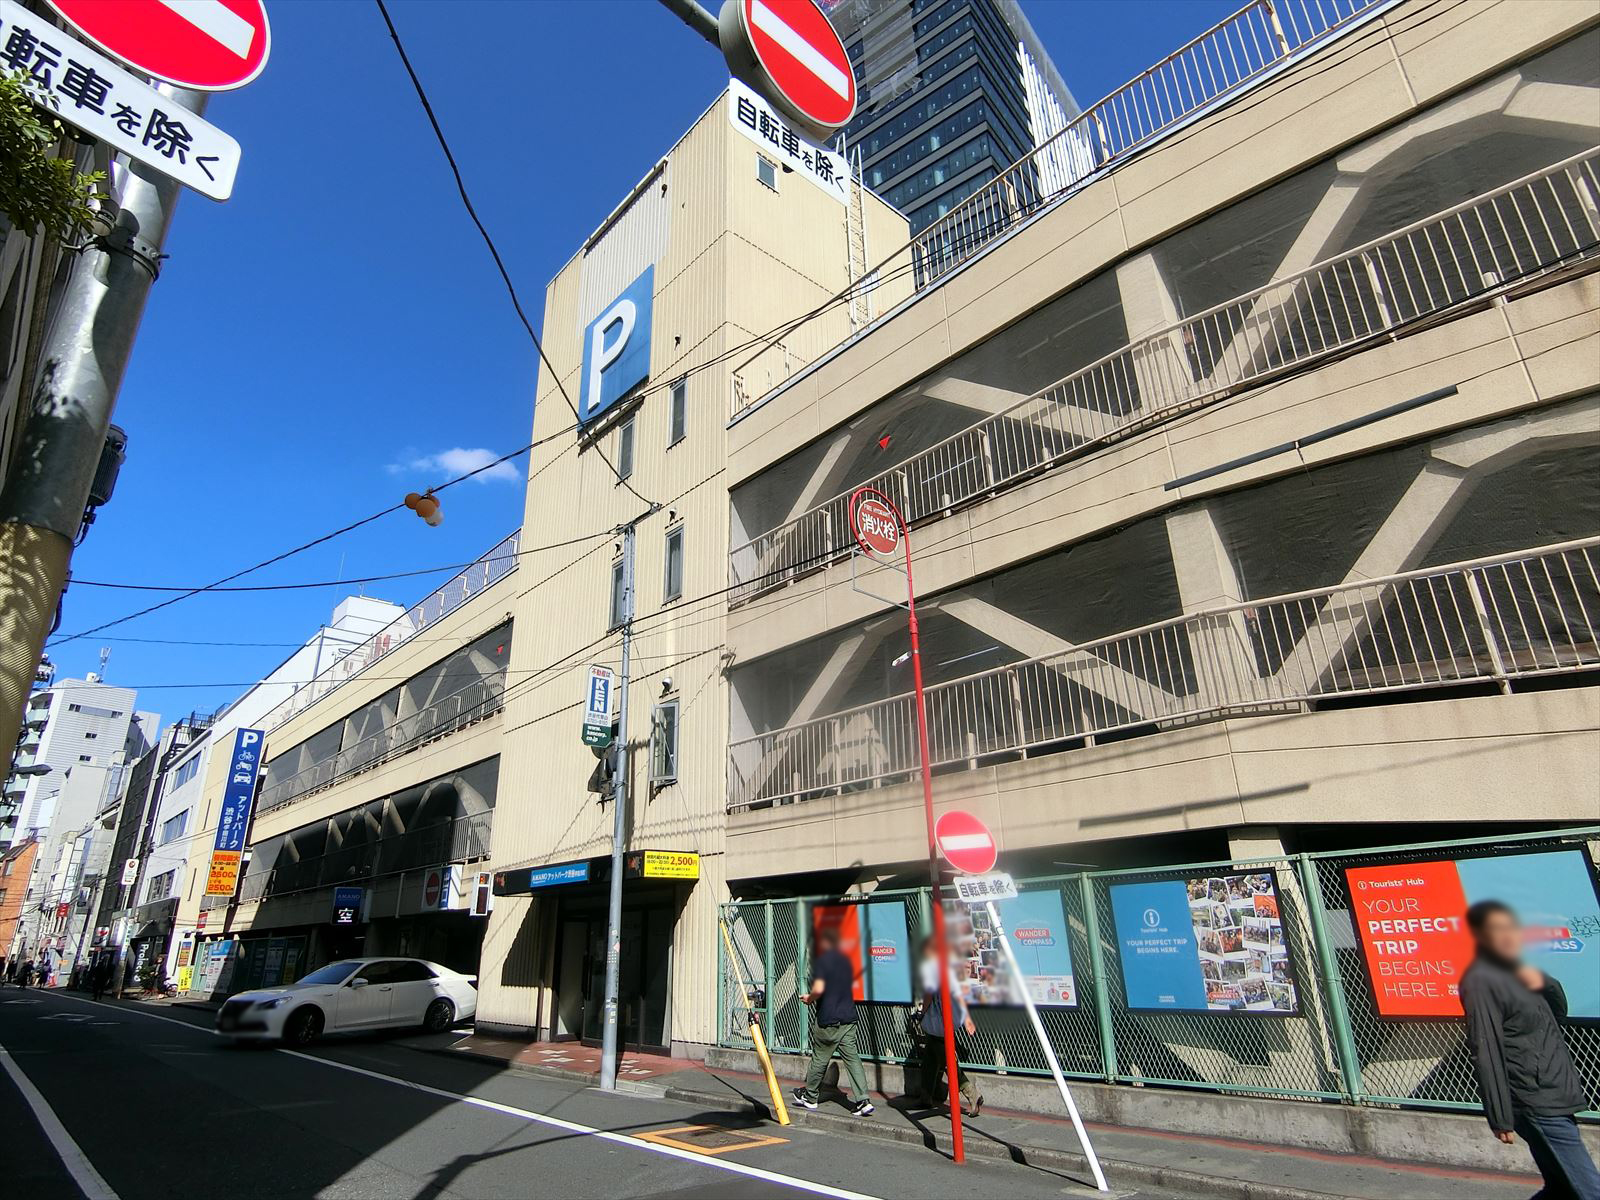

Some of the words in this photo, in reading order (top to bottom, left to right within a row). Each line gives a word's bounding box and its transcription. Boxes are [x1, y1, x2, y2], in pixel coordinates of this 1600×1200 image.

[0, 19, 220, 182] 転車を除く
[737, 95, 845, 193] 自転車を除く
[588, 298, 637, 415] P
[861, 511, 896, 542] 消火栓
[593, 678, 606, 713] KEN
[241, 731, 259, 748] P
[229, 795, 248, 849] アットパーク
[960, 879, 1011, 898] 自転車を除く
[1369, 879, 1403, 888] Tourists'
[1406, 877, 1425, 886] Hub
[1362, 898, 1420, 914] YOUR
[337, 907, 354, 923] 空
[1018, 929, 1047, 937] WANDER
[1368, 916, 1459, 934] PERFECT
[1023, 938, 1053, 946] COMPASS
[1372, 940, 1418, 955] TRIP
[1378, 960, 1455, 976] BEGINS
[1383, 981, 1444, 997] HERE.
